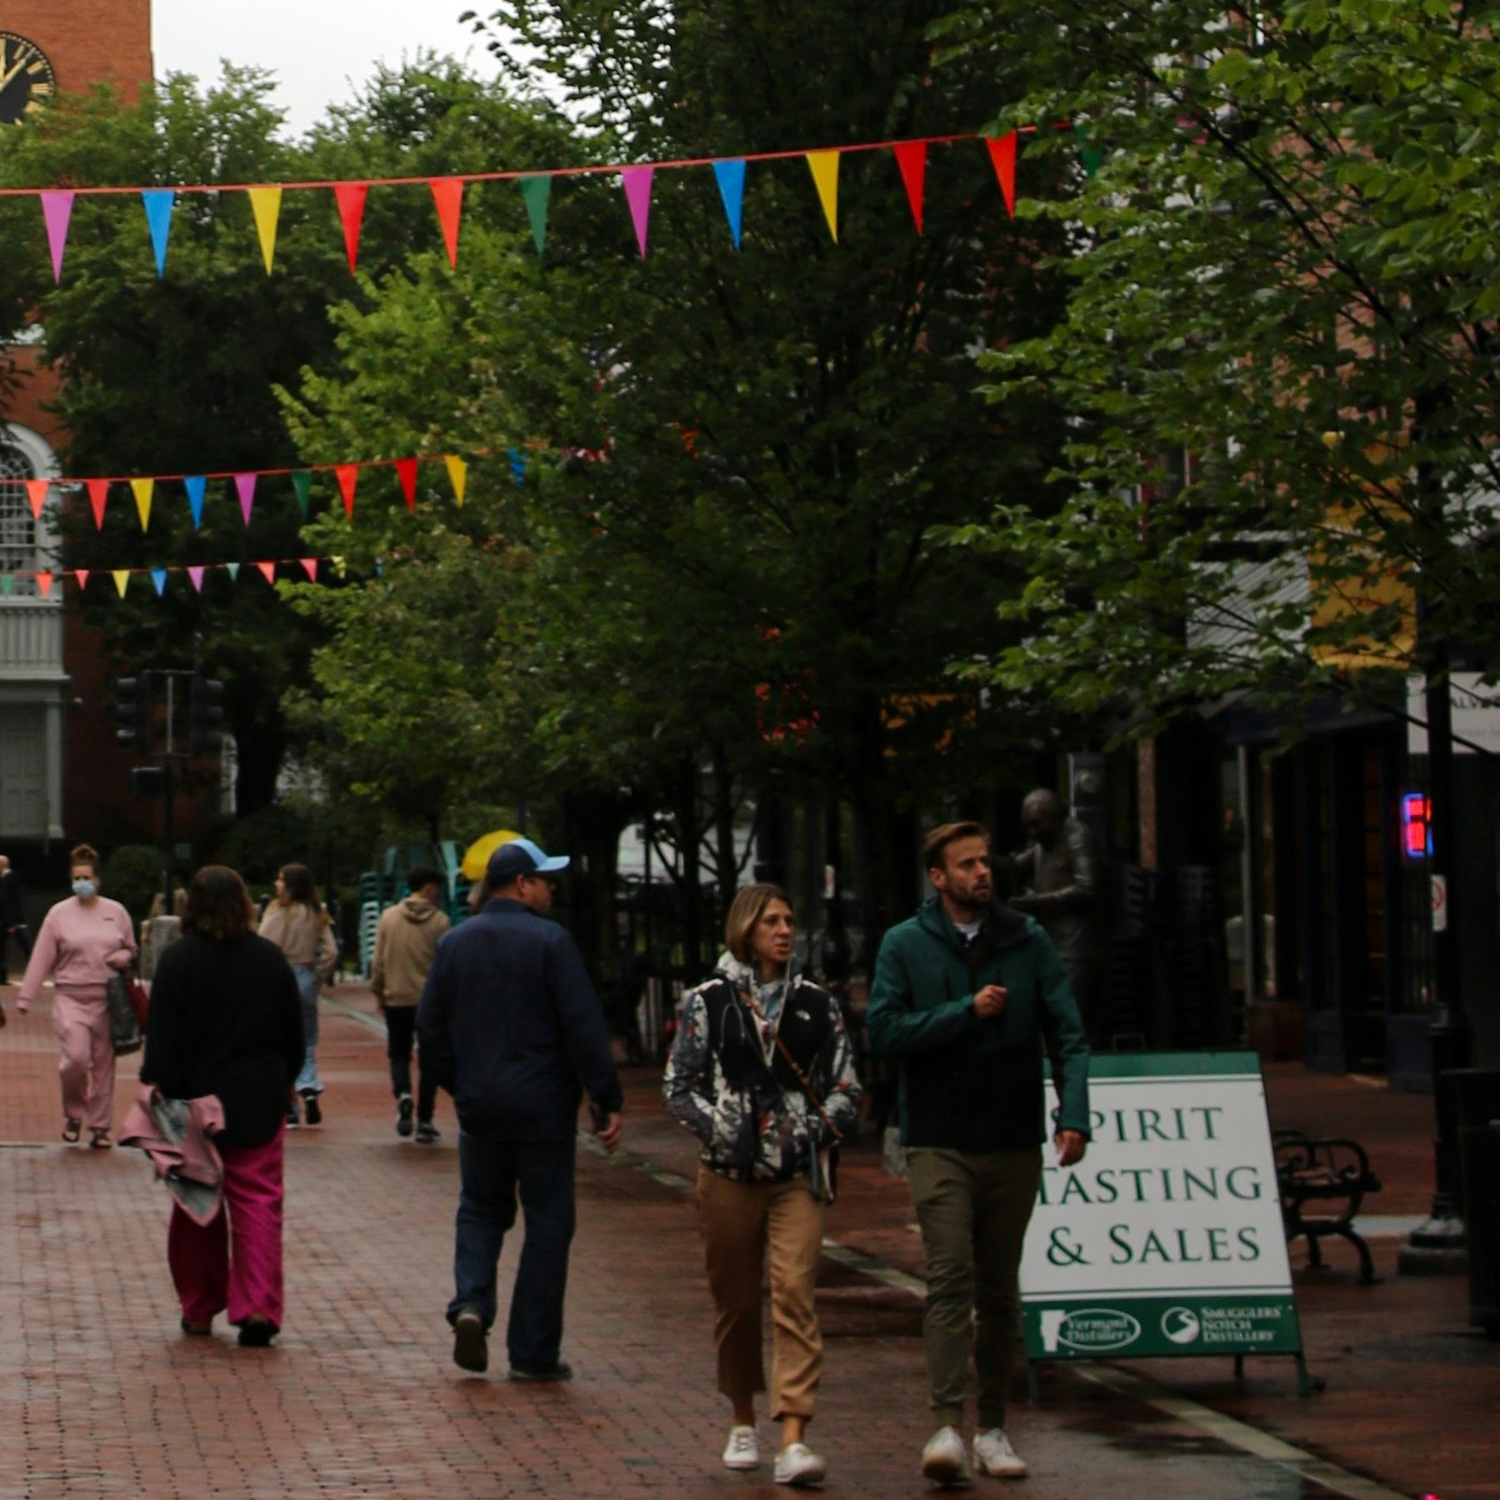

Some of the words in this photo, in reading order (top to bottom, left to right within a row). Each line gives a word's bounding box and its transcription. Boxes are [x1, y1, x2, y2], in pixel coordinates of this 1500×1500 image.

[1051, 1106, 1222, 1143] PIRIT
[1038, 1166, 1262, 1205] TASTING
[1046, 1226, 1092, 1267] &
[1109, 1224, 1261, 1265] SALES
